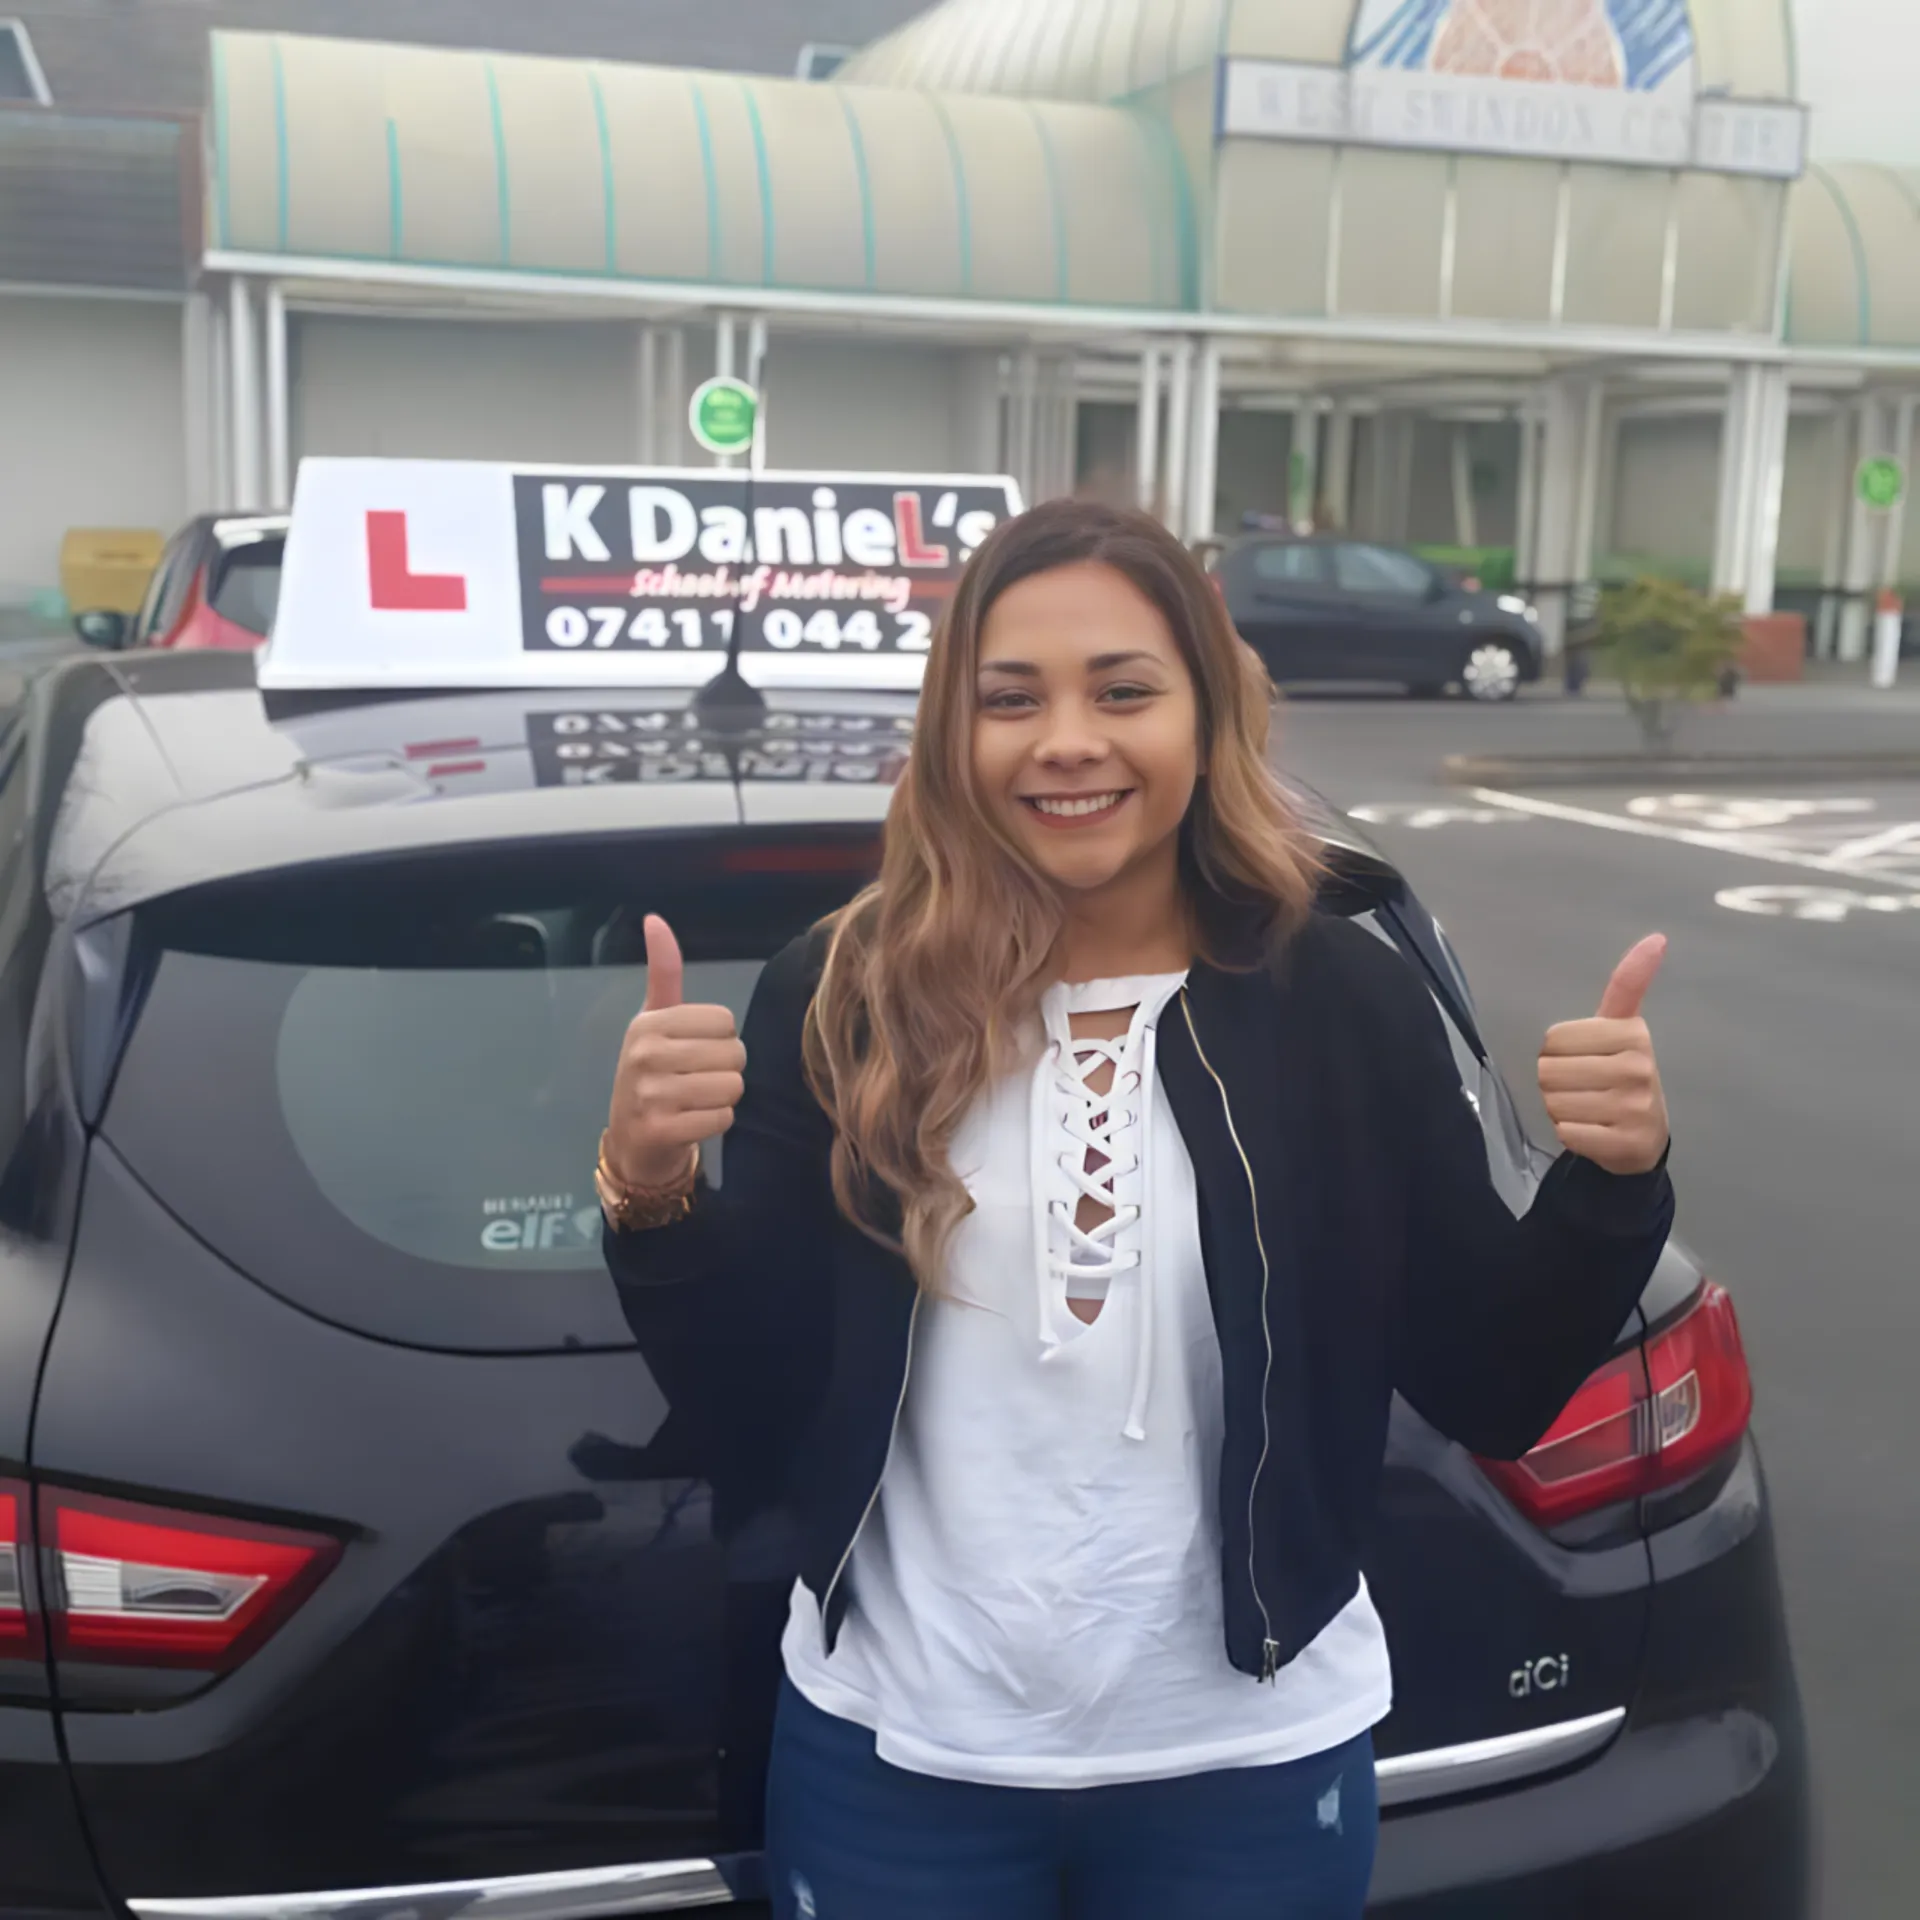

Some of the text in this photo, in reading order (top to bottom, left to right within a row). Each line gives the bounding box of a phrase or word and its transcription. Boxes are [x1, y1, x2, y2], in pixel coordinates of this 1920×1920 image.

[542, 483, 612, 562] K
[366, 510, 468, 611] L
[629, 562, 730, 598] School
[729, 564, 771, 613] of
[545, 605, 735, 649] 07411
[762, 608, 884, 651] 044
[480, 1211, 568, 1251] elf
